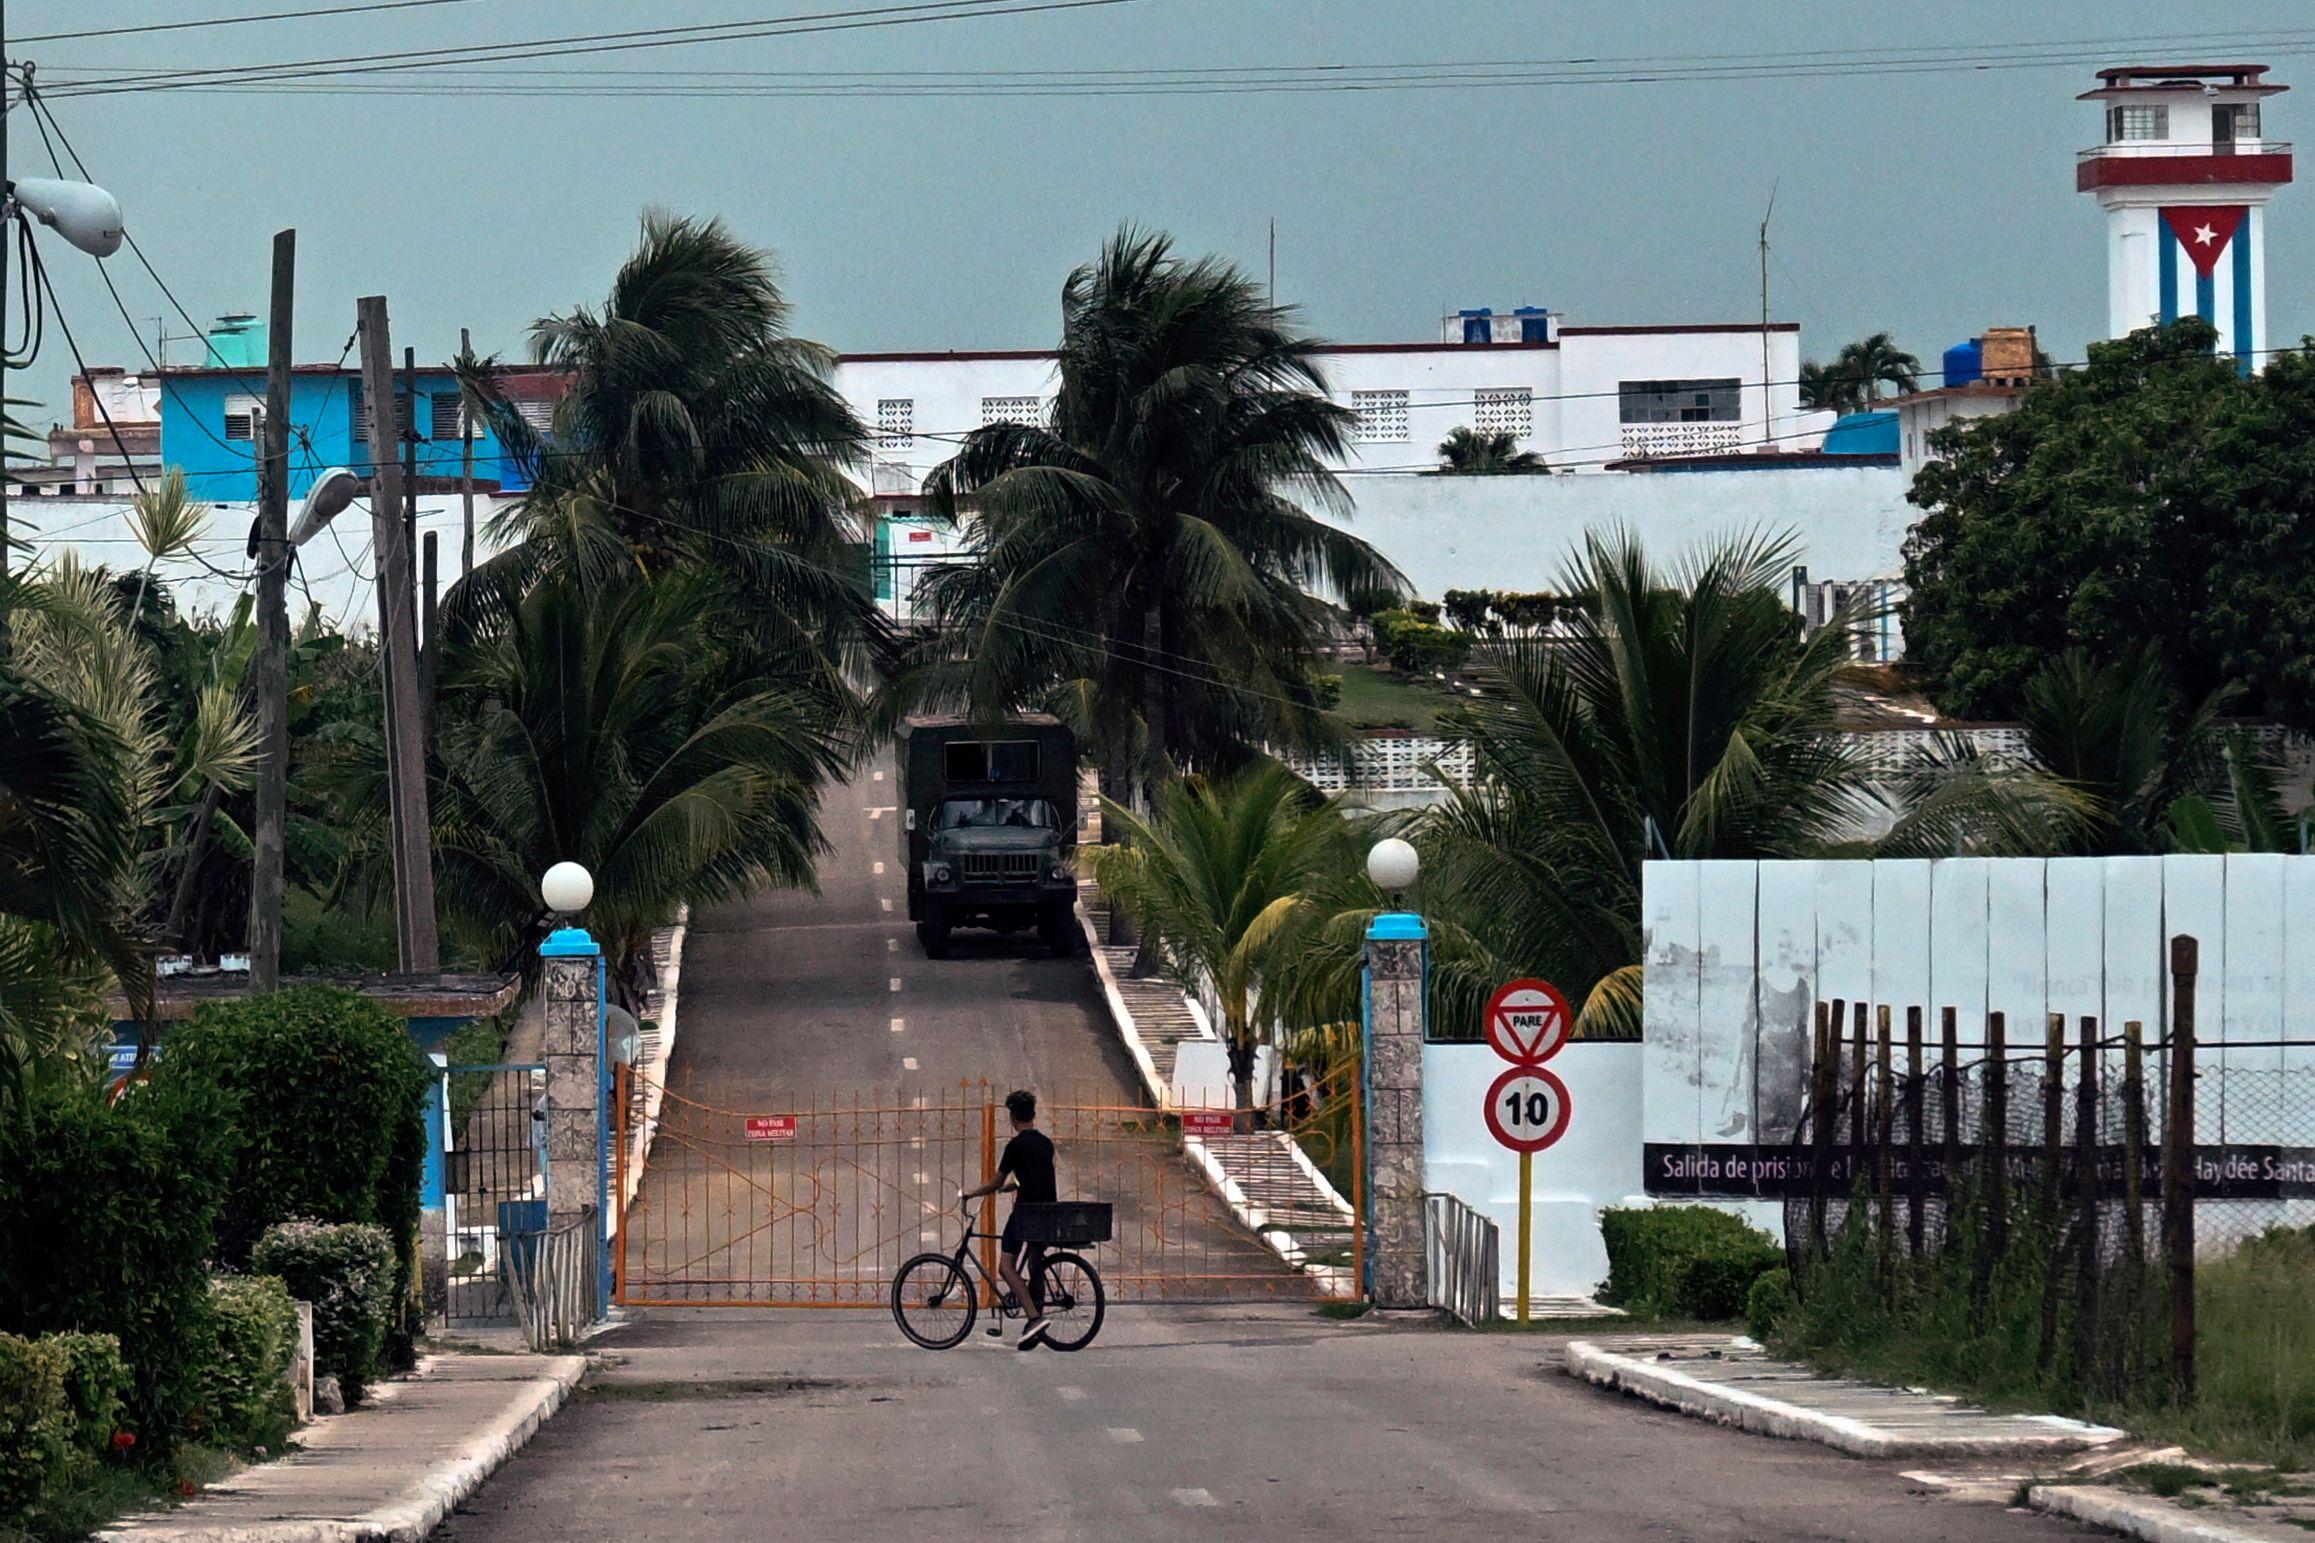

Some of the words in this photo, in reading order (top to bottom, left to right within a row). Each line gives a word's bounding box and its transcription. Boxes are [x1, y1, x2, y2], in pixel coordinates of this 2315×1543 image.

[1513, 1015, 1542, 1027] PARE
[1505, 1092, 1548, 1126] 10
[757, 1119, 768, 1127] NO
[1662, 1154, 1720, 1179] Salida
[1725, 1154, 1747, 1179] de
